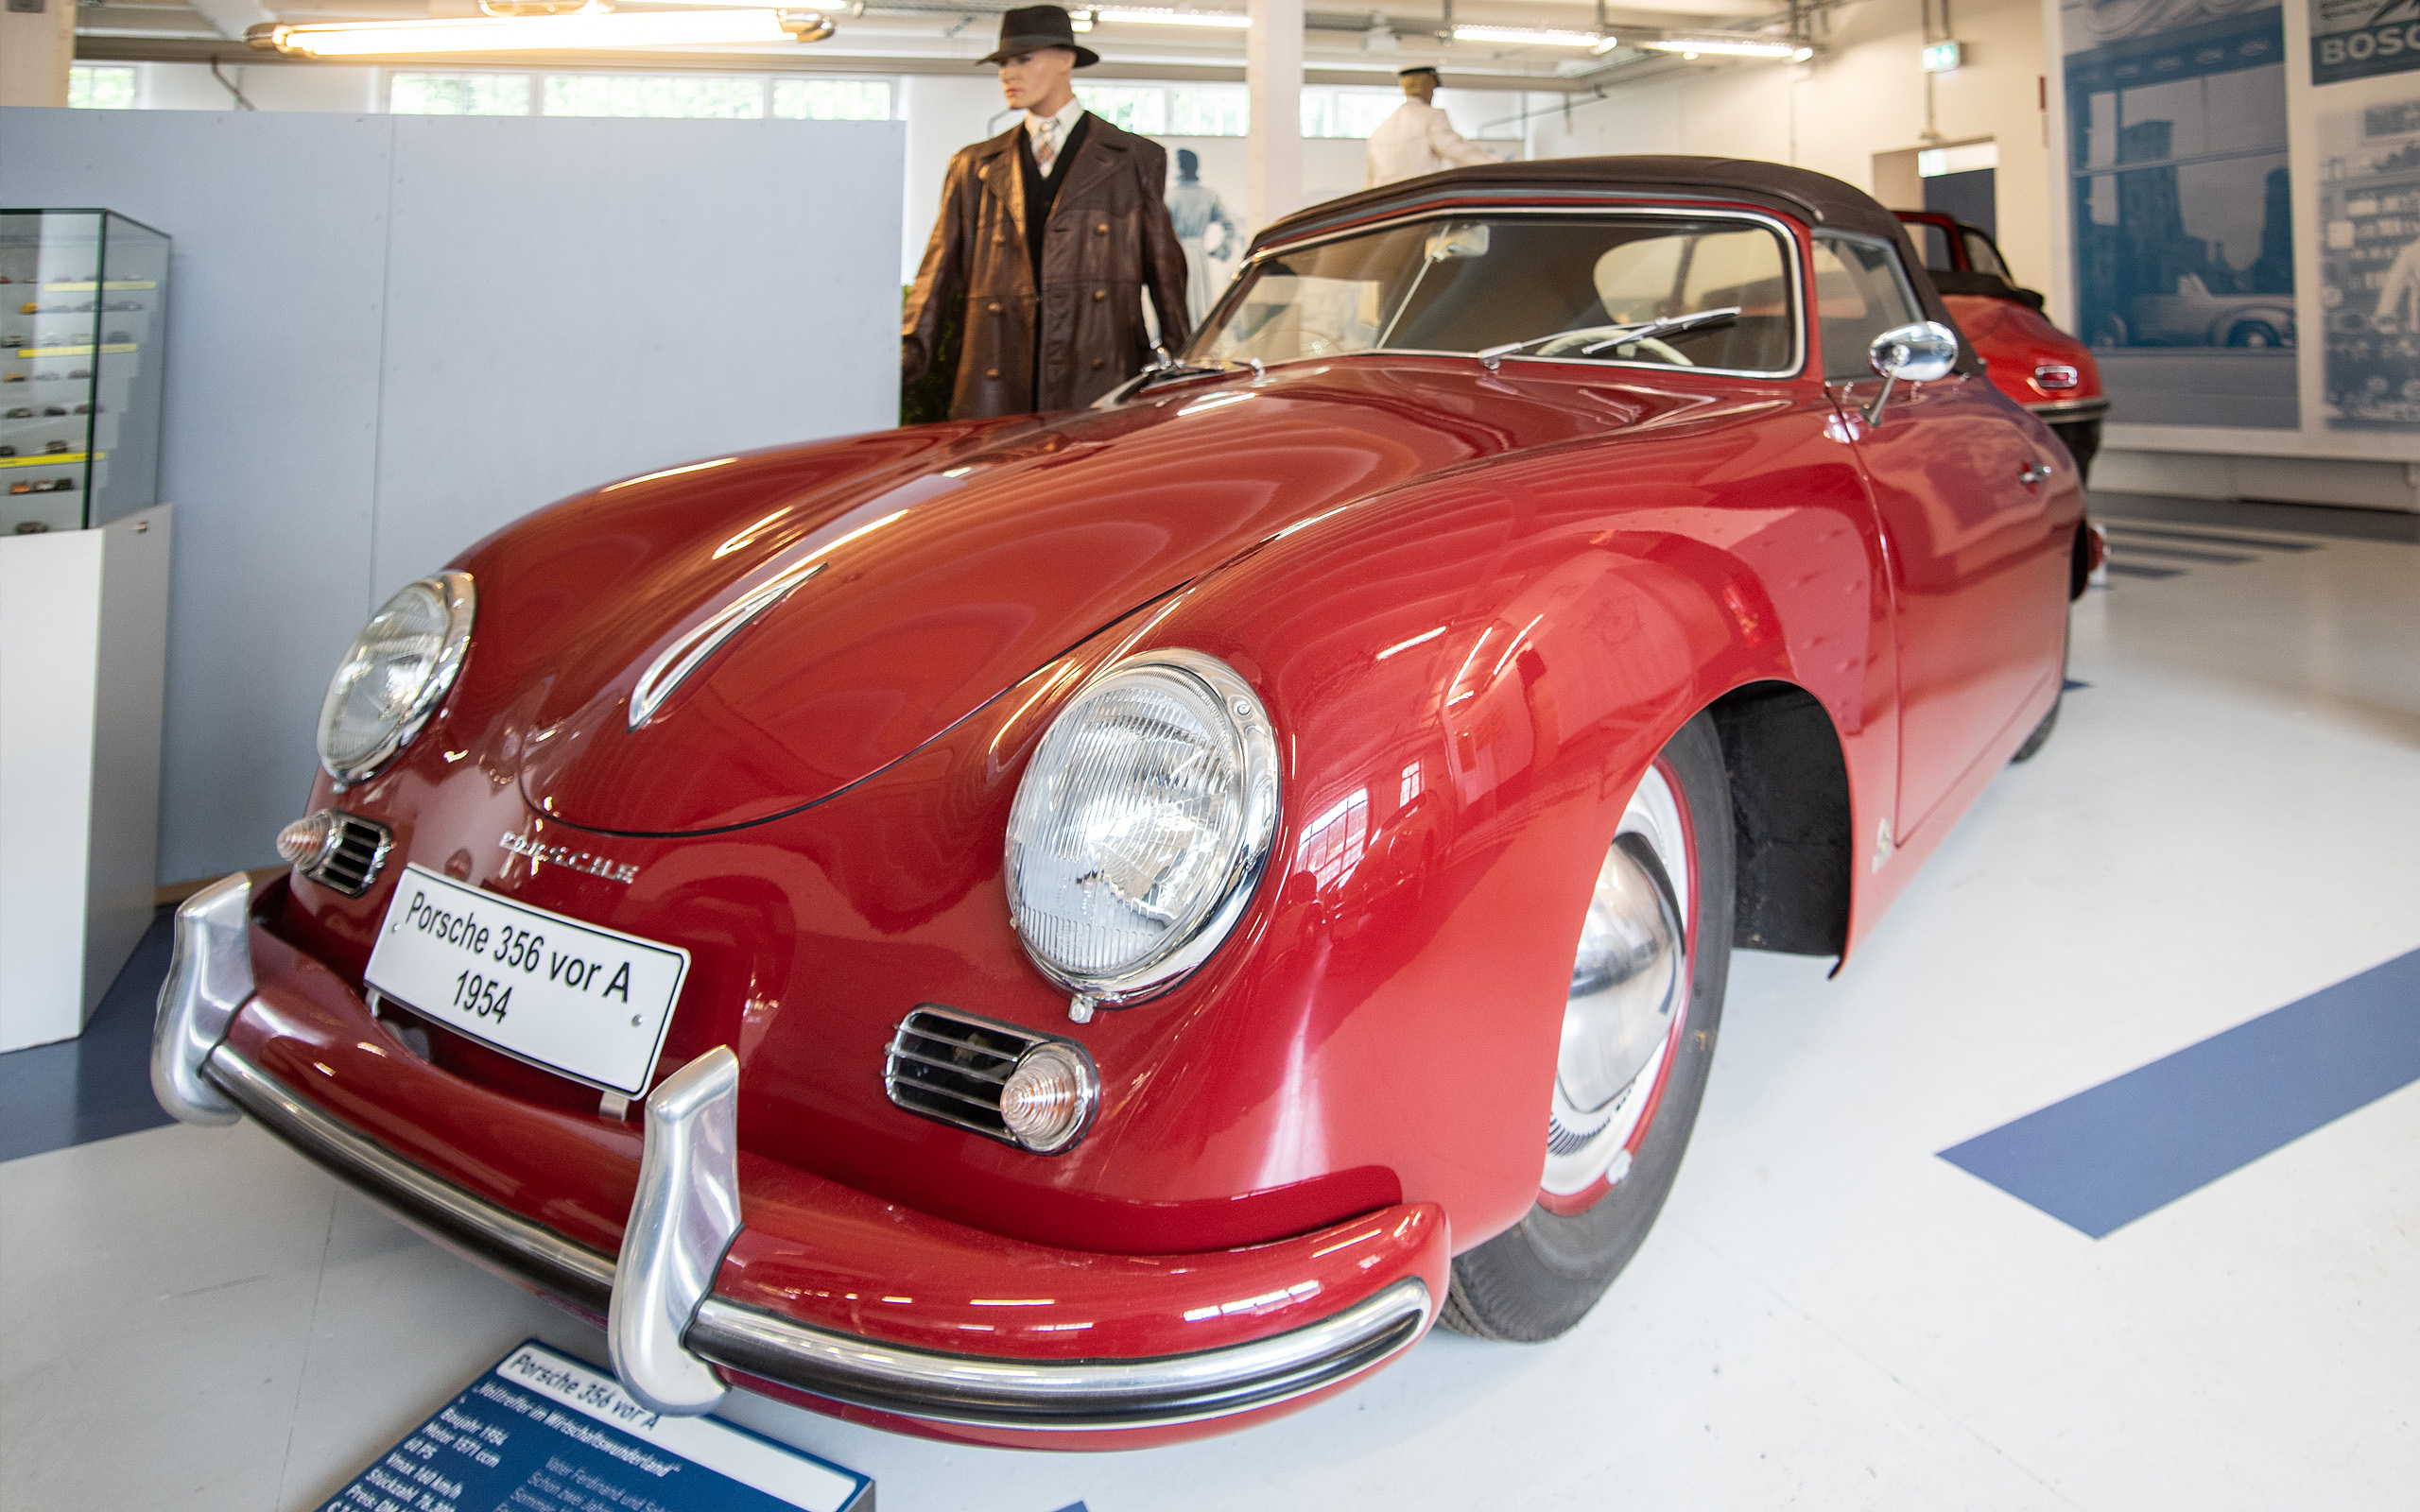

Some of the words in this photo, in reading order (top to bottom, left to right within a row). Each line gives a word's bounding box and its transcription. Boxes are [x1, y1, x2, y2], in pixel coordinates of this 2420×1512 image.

[405, 891, 490, 954] Porsche
[493, 925, 545, 973] 356
[549, 951, 603, 991] vor
[602, 961, 631, 1004] A
[453, 970, 513, 1025] 1954
[509, 1352, 579, 1395] Porsche
[578, 1382, 614, 1409] 356
[613, 1398, 647, 1423] vor
[640, 1414, 661, 1432] A
[527, 1403, 549, 1422] im
[404, 1435, 424, 1452] 60
[416, 1441, 440, 1460] PS
[422, 1420, 458, 1445] Motor
[475, 1448, 502, 1469] ccm
[440, 1405, 483, 1435] Baujahr
[478, 1423, 510, 1447] 1954
[344, 1482, 379, 1509] Preis:
[365, 1466, 421, 1503] Stückzahl
[386, 1450, 417, 1476] Vmax
[429, 1473, 464, 1500] km/h
[527, 1469, 563, 1496] Schon
[557, 1486, 587, 1507] zwei
[545, 1454, 575, 1477] Vater
[570, 1466, 628, 1502] Ferdinand
[619, 1492, 649, 1512] und
